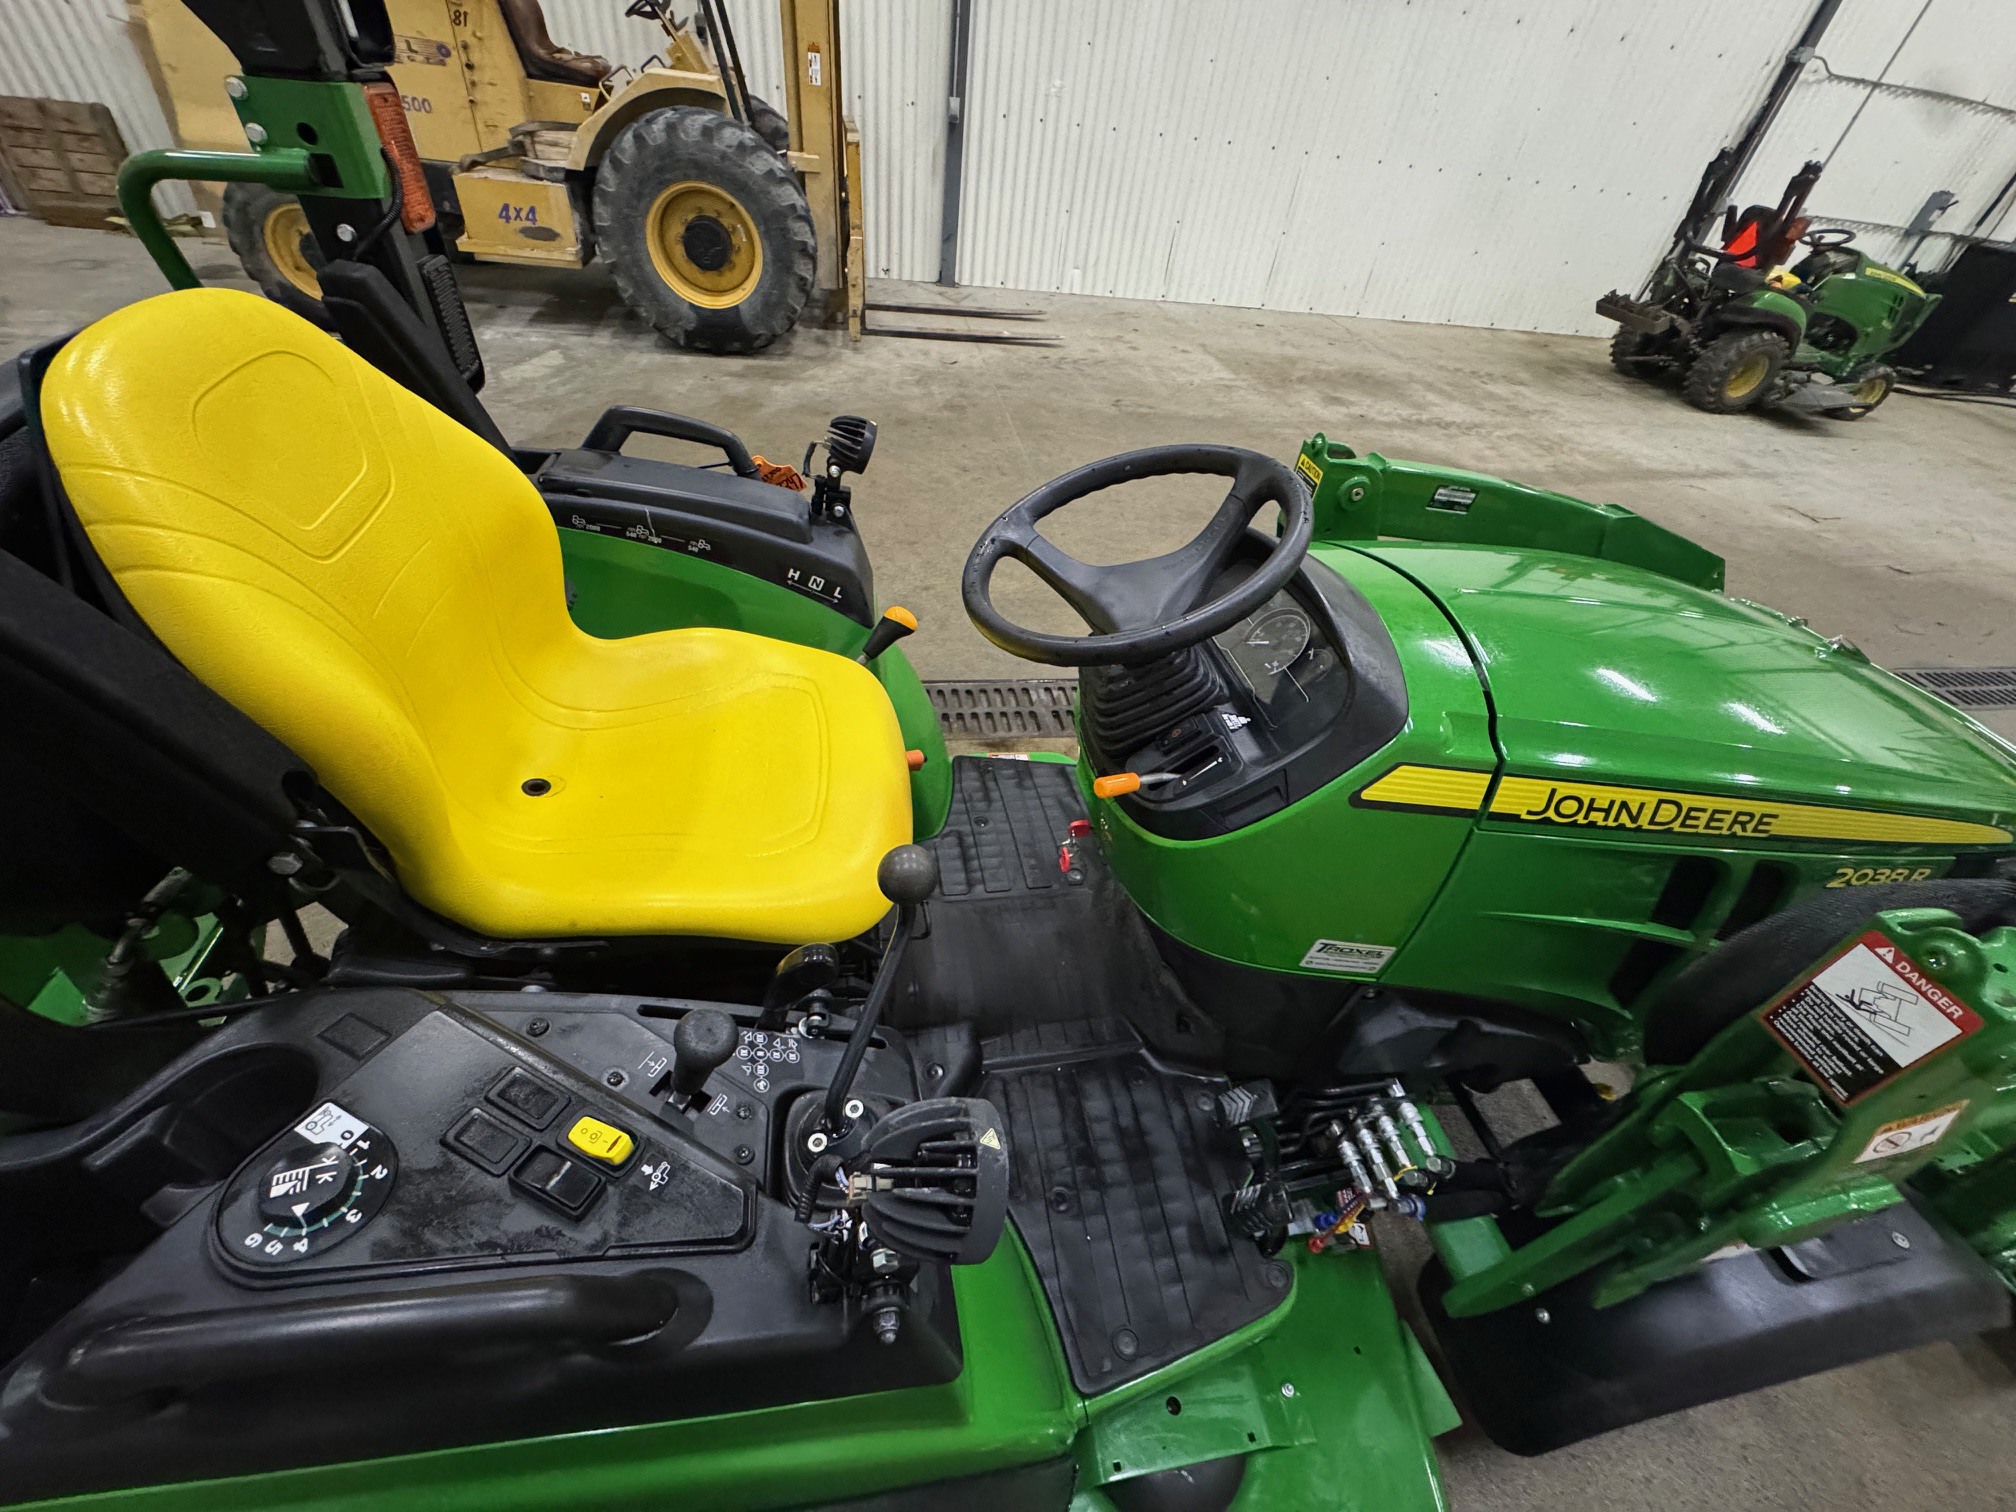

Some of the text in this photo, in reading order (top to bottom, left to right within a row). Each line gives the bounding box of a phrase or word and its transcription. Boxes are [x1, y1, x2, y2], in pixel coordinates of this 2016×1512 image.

[1526, 788, 1780, 834] JOHN DEERE
[1895, 961, 1963, 1019] DANGER
[370, 1164, 388, 1180] 2
[345, 1208, 362, 1224] 3
[264, 1239, 283, 1256] 5
[293, 1237, 309, 1253] 4
